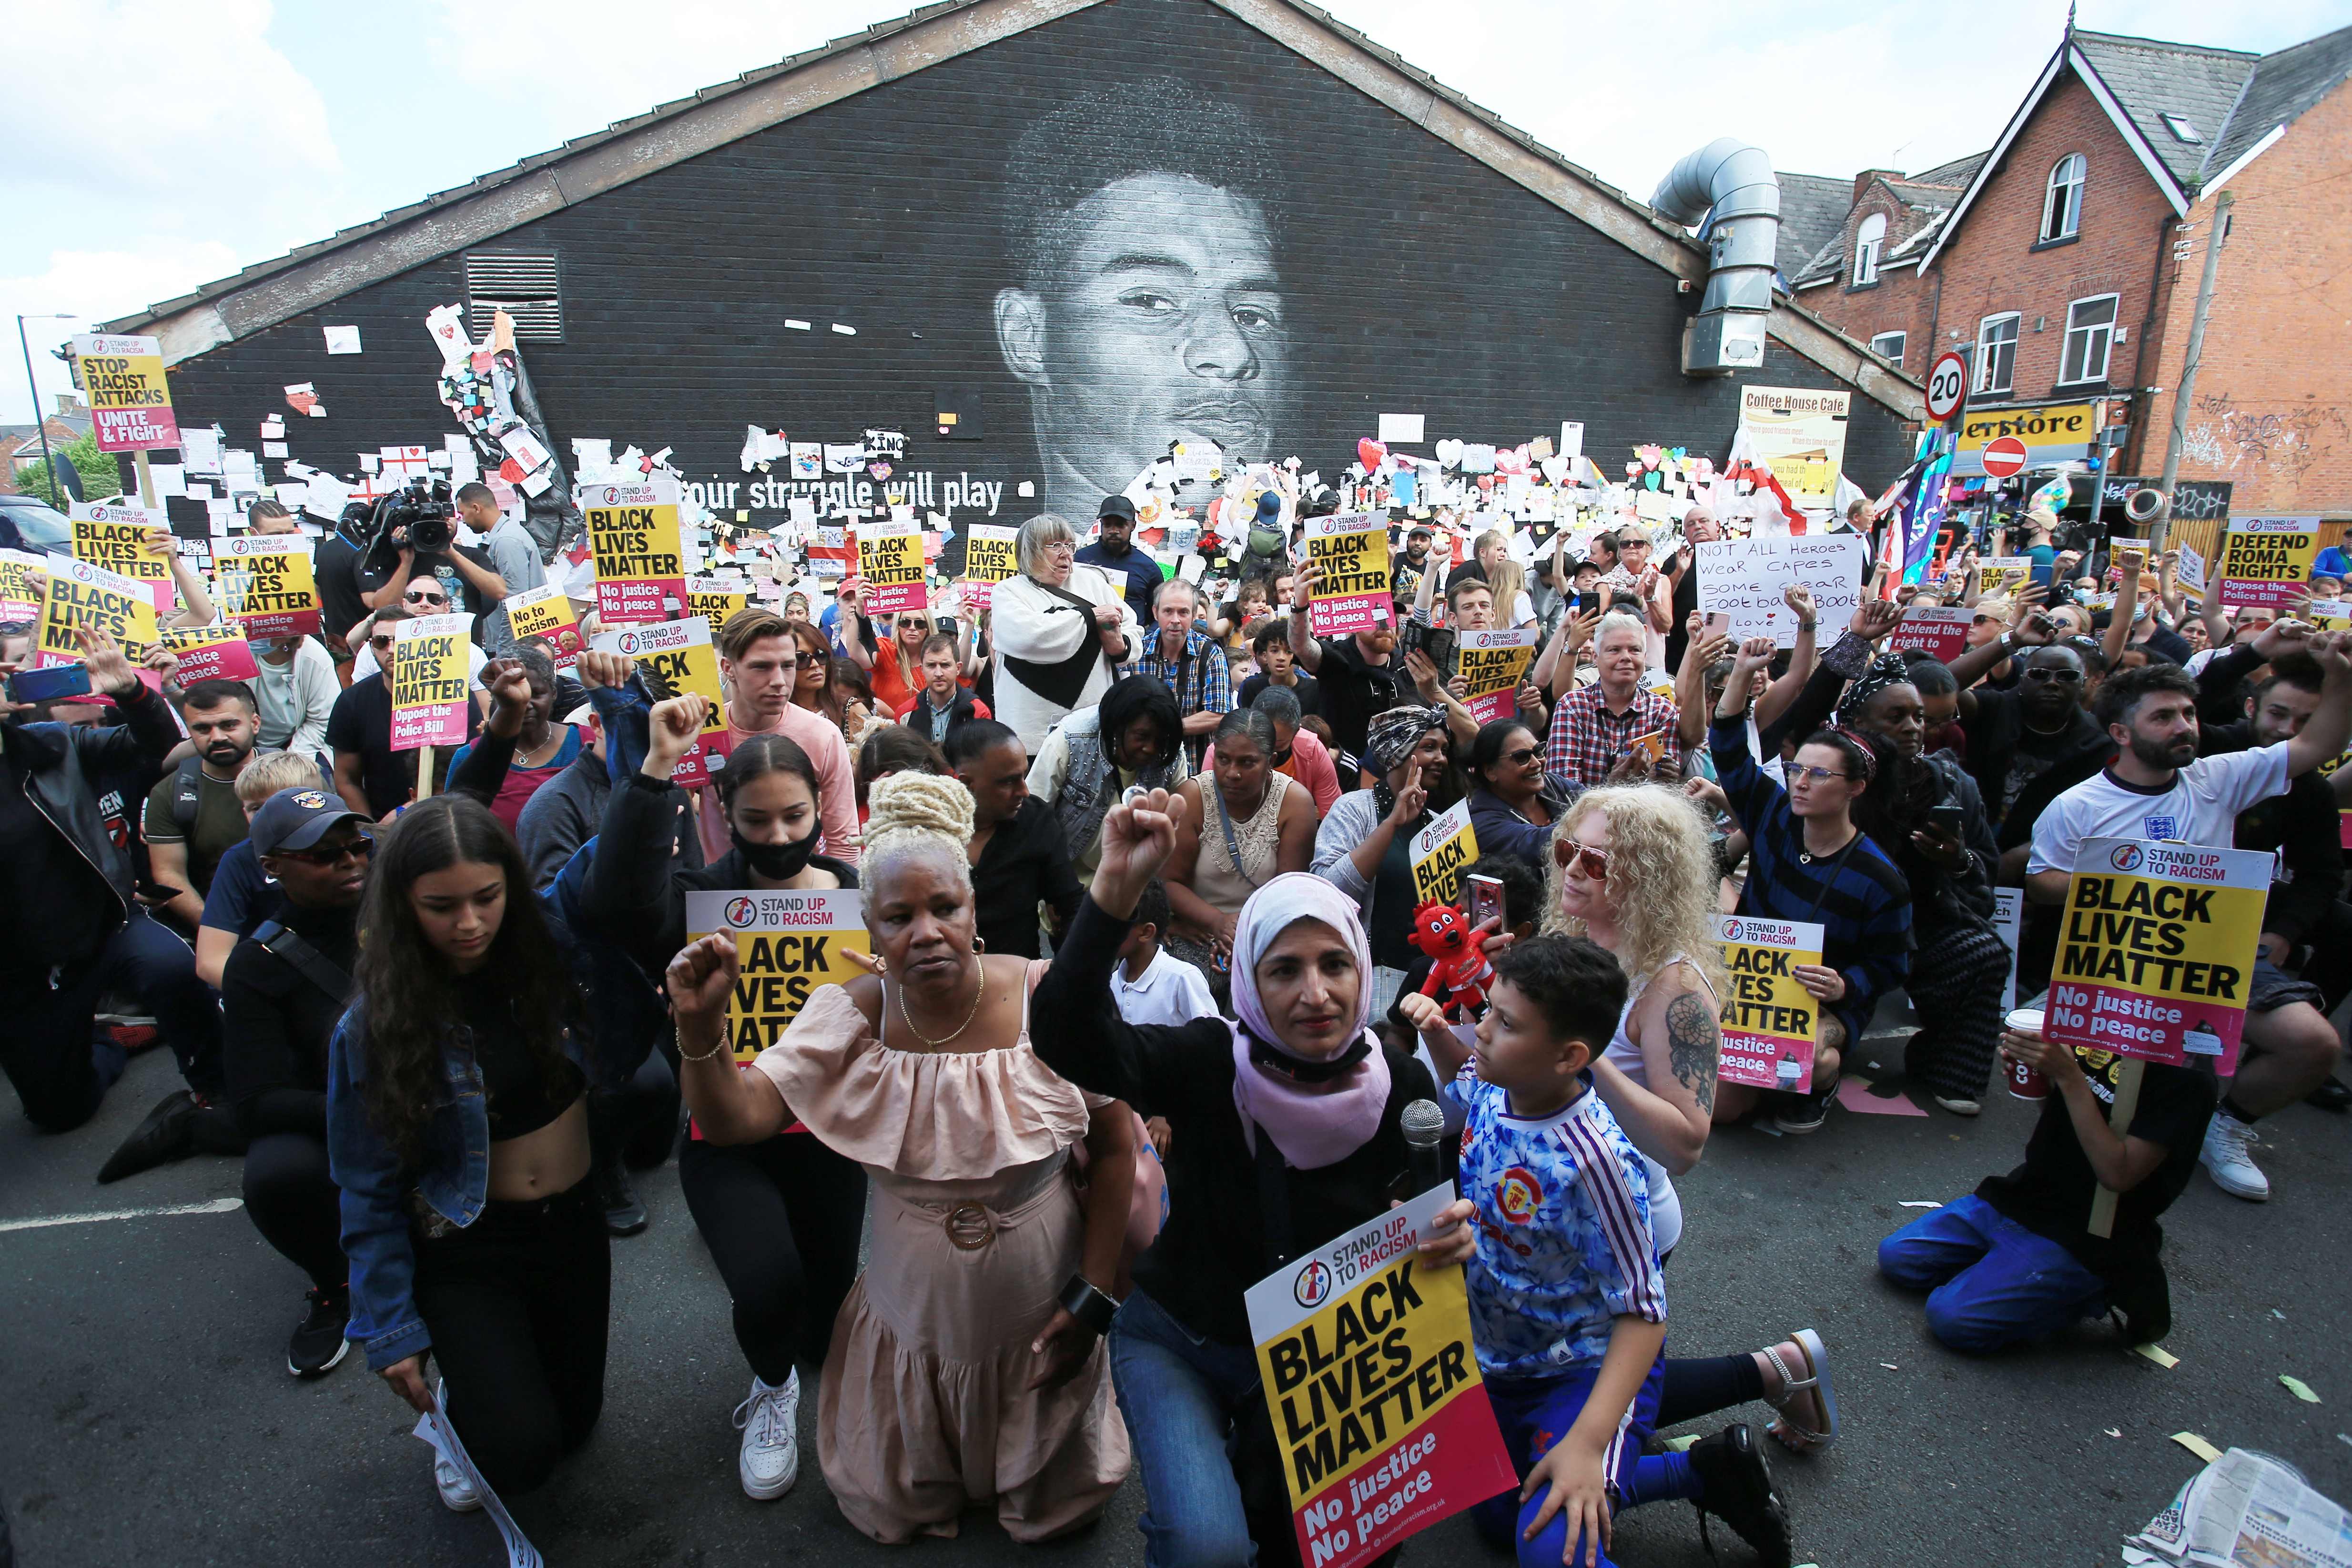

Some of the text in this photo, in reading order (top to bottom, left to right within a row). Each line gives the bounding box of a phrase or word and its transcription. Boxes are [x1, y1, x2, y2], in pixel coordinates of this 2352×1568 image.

[84, 359, 129, 374] STOP
[88, 374, 146, 390] RACIST
[1931, 371, 1959, 402] 20
[94, 389, 164, 405] ATTACKS
[1747, 393, 1782, 408] Coffee
[1784, 395, 1817, 411] House
[97, 410, 148, 427] UNITE
[102, 425, 164, 443] & FIGHT
[1774, 465, 1798, 475] you had
[1778, 477, 1802, 487] meal of
[621, 487, 640, 495] STAND
[882, 472, 935, 508] will
[943, 472, 1003, 517] play
[590, 508, 656, 532] BLACK
[1348, 523, 1371, 531] RACISM
[75, 523, 146, 543] BLACK
[77, 541, 138, 559] LIVES
[594, 532, 649, 554] LIVES
[861, 537, 908, 555] BLACK
[971, 540, 1014, 554] BLACK
[1310, 534, 1369, 557] BLACK
[1701, 544, 1737, 557] NOT
[1747, 543, 1777, 556] ALL
[2230, 535, 2309, 549] DEFEND
[862, 554, 902, 570] LIVES
[969, 554, 1006, 567] LIVES
[2228, 549, 2287, 564] ROMA
[220, 556, 290, 577] BLACK
[597, 554, 679, 577] MATTER
[1312, 555, 1360, 576] LIVES
[2226, 564, 2301, 579] RIGHTS
[864, 567, 922, 584] MATTER
[1313, 571, 1386, 596] MATTER
[107, 582, 135, 596] RACISM
[223, 575, 284, 595] LIVES
[600, 583, 659, 599] No justice
[879, 587, 908, 598] justice
[2224, 580, 2287, 592] Oppose the
[52, 578, 136, 618] BLACK
[226, 592, 313, 613] MATTER
[688, 595, 730, 609] BLACK
[866, 597, 906, 609] No peace
[2223, 591, 2277, 601] Police Bill
[602, 598, 656, 613] No peace
[1313, 598, 1369, 615] No justice
[50, 602, 126, 637] LIVES
[251, 616, 294, 627] justice
[514, 607, 545, 624] No to
[1315, 612, 1366, 627] No peace
[252, 626, 288, 635] peace
[517, 616, 559, 636] racism
[641, 626, 681, 640] STAND UP
[1899, 623, 1962, 635] Defend the
[397, 637, 454, 663] BLACK
[642, 635, 688, 650] TO RACISM
[1895, 637, 1939, 649] right to
[1463, 648, 1517, 667] BLACK
[179, 665, 221, 684] peace
[396, 659, 441, 684] LIVES
[1462, 665, 1505, 682] LIVES
[395, 678, 464, 706] MATTER
[1472, 696, 1498, 713] justice
[395, 705, 452, 724] Oppose the
[395, 720, 444, 738] Police Bill
[1432, 819, 1447, 836] STAND
[1442, 821, 1459, 838] RACISM
[1416, 835, 1466, 891] BLACK
[2148, 848, 2221, 866] STAND UP
[2147, 861, 2226, 881] TO RACISM
[762, 898, 826, 912] STAND UP
[2074, 877, 2217, 924] BLACK
[762, 912, 833, 926] TO RACISM
[1746, 922, 1792, 935] STAND UP
[2068, 911, 2185, 956] LIVES
[1746, 932, 1796, 946] TO RACISM
[2061, 944, 2240, 1001] MATTER
[2056, 986, 2182, 1024] No justice
[2052, 1007, 2084, 1028] No
[2090, 1016, 2166, 1044] peace
[2058, 1033, 2118, 1048] standuptoracism.org.uk
[1333, 1216, 1406, 1267] STAND UP
[1335, 1230, 1418, 1287] TO RACISM
[1269, 1259, 1423, 1396] BLACK
[1280, 1326, 1412, 1447] LIVES
[1292, 1340, 1469, 1496] MATTER
[1304, 1499, 1343, 1538] No
[1349, 1432, 1436, 1517] justice
[1311, 1470, 1432, 1568] No peace
[1381, 1498, 1445, 1542] standuptoracism.org.uk
